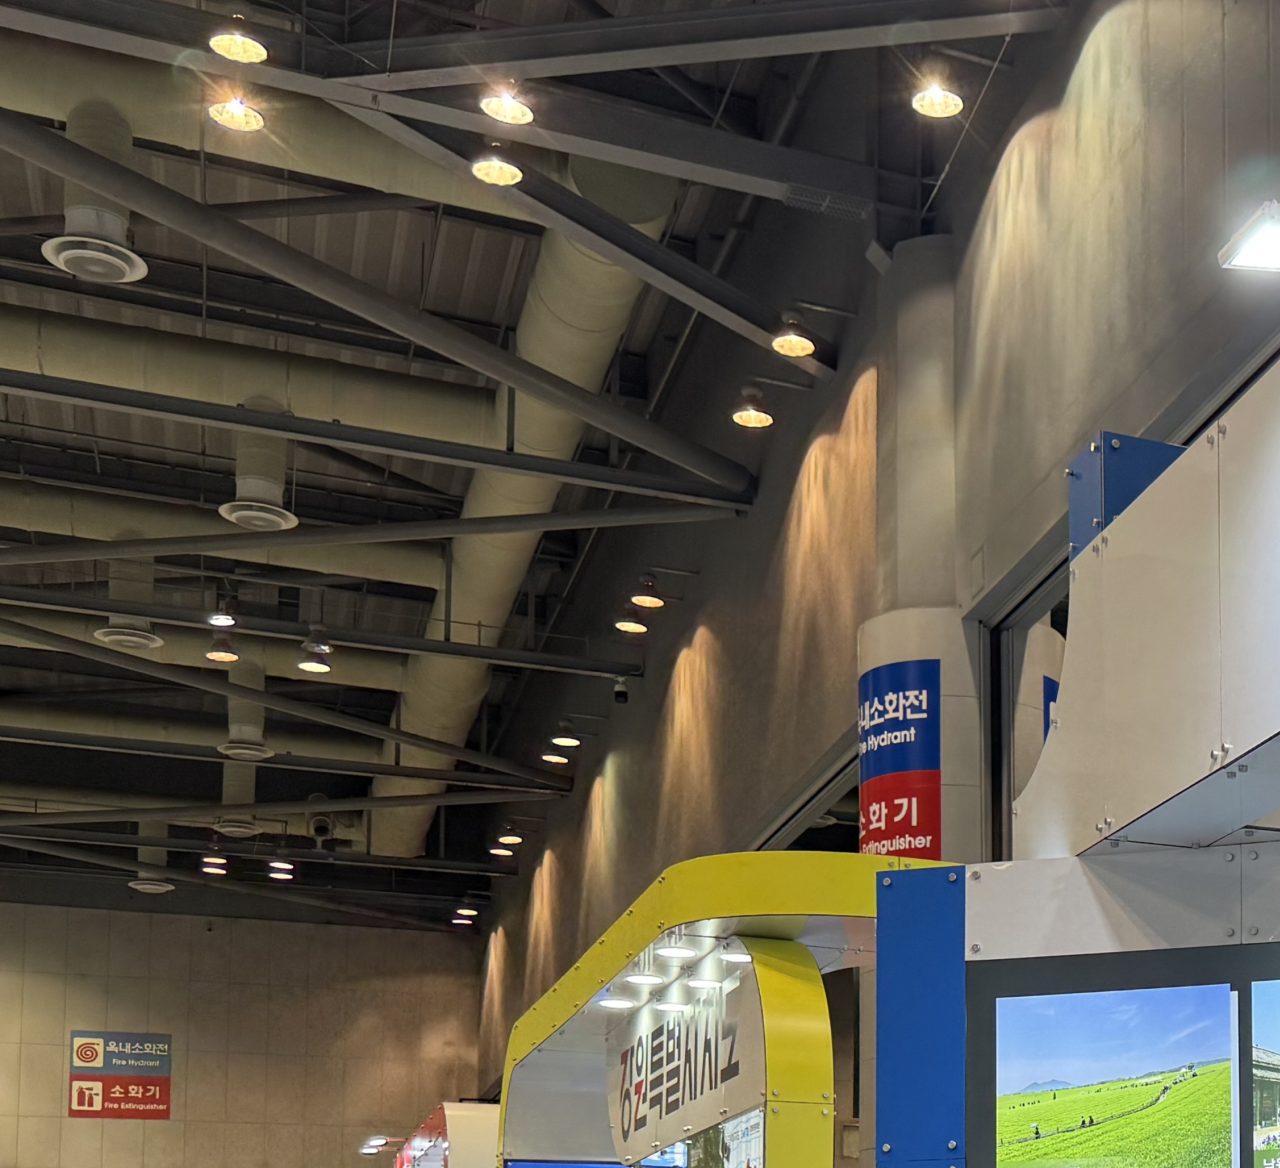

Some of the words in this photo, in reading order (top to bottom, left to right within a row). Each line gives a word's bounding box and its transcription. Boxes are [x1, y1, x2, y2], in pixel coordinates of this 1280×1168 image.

[858, 689, 928, 735] 내소화전
[867, 727, 916, 751] Hydrant
[106, 1041, 168, 1055] 옥내소화전
[112, 1058, 127, 1066] Fire
[128, 1058, 160, 1067] Hydrant
[110, 1084, 160, 1099] 소화기
[104, 1101, 118, 1109] Fire
[120, 1101, 167, 1110] Extinguisher
